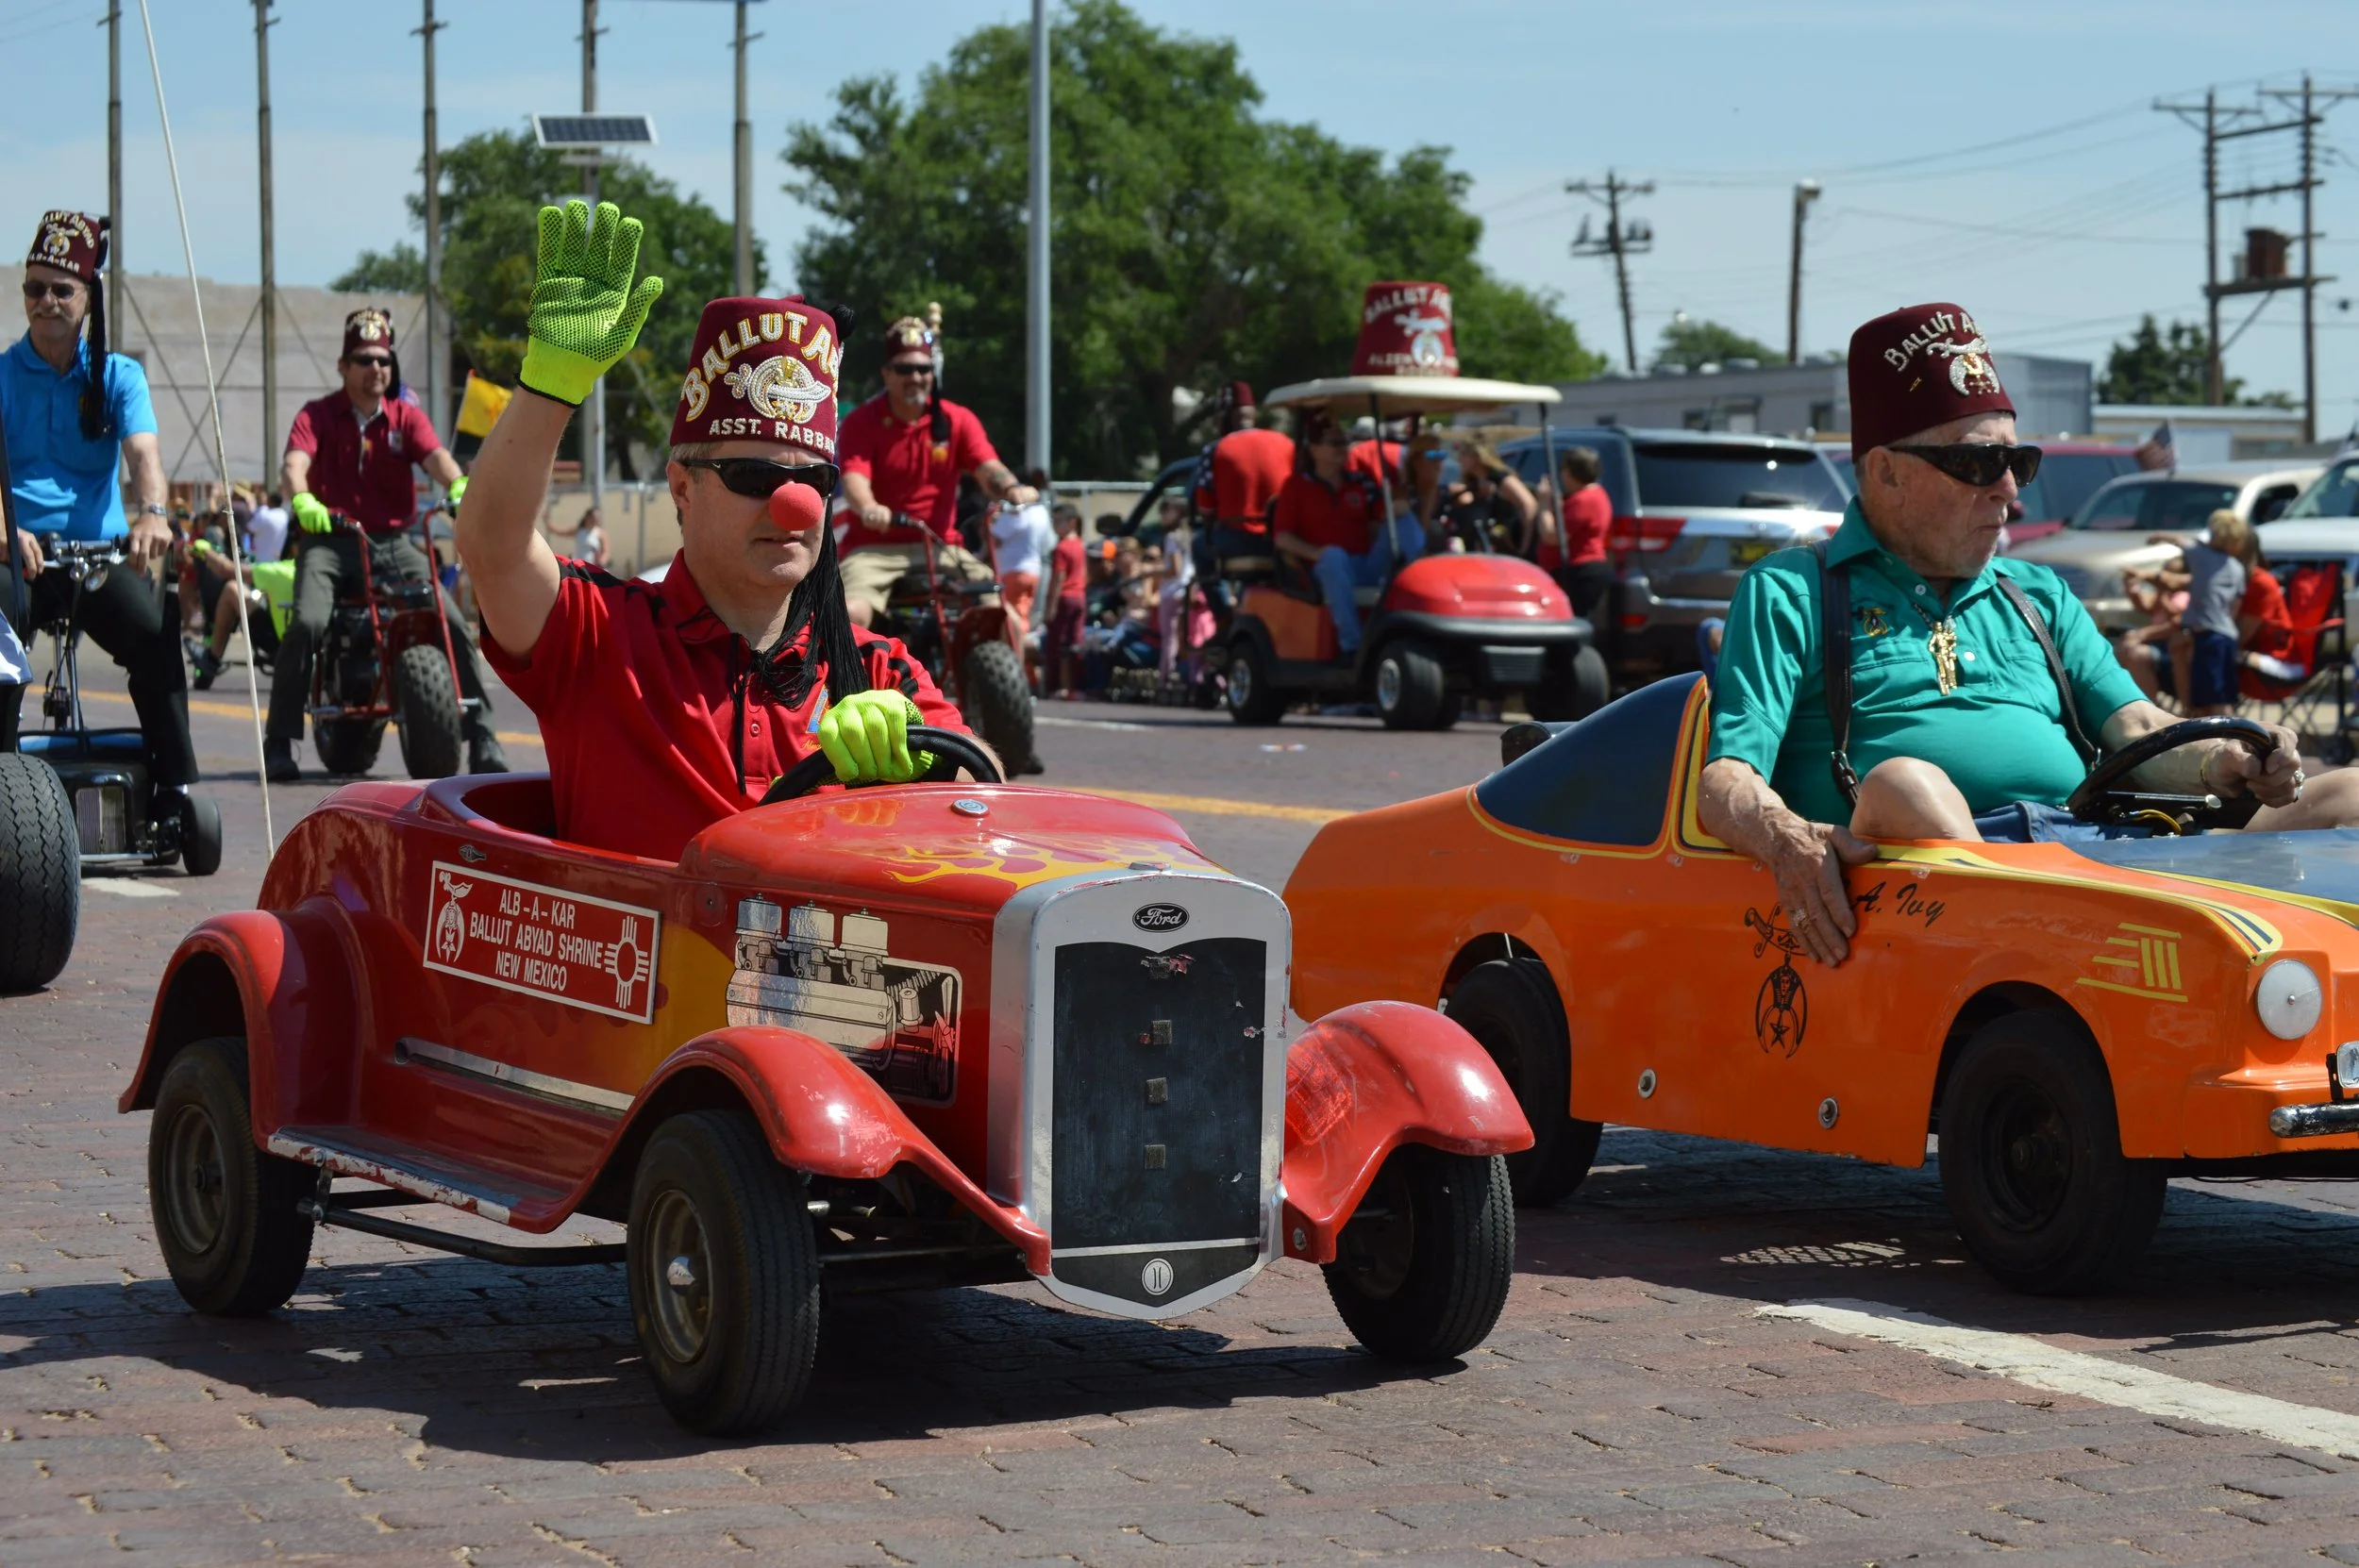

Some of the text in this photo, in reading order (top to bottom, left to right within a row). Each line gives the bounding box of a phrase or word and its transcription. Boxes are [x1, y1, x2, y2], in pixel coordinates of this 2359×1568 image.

[680, 310, 808, 422] BALLUT
[1883, 311, 1956, 373] BALLUT
[709, 418, 761, 436] ASST.
[469, 911, 603, 970] BALLUT ABYAD SHRINE
[1140, 908, 1182, 926] Ford
[494, 951, 567, 992] NEW MEXICO
